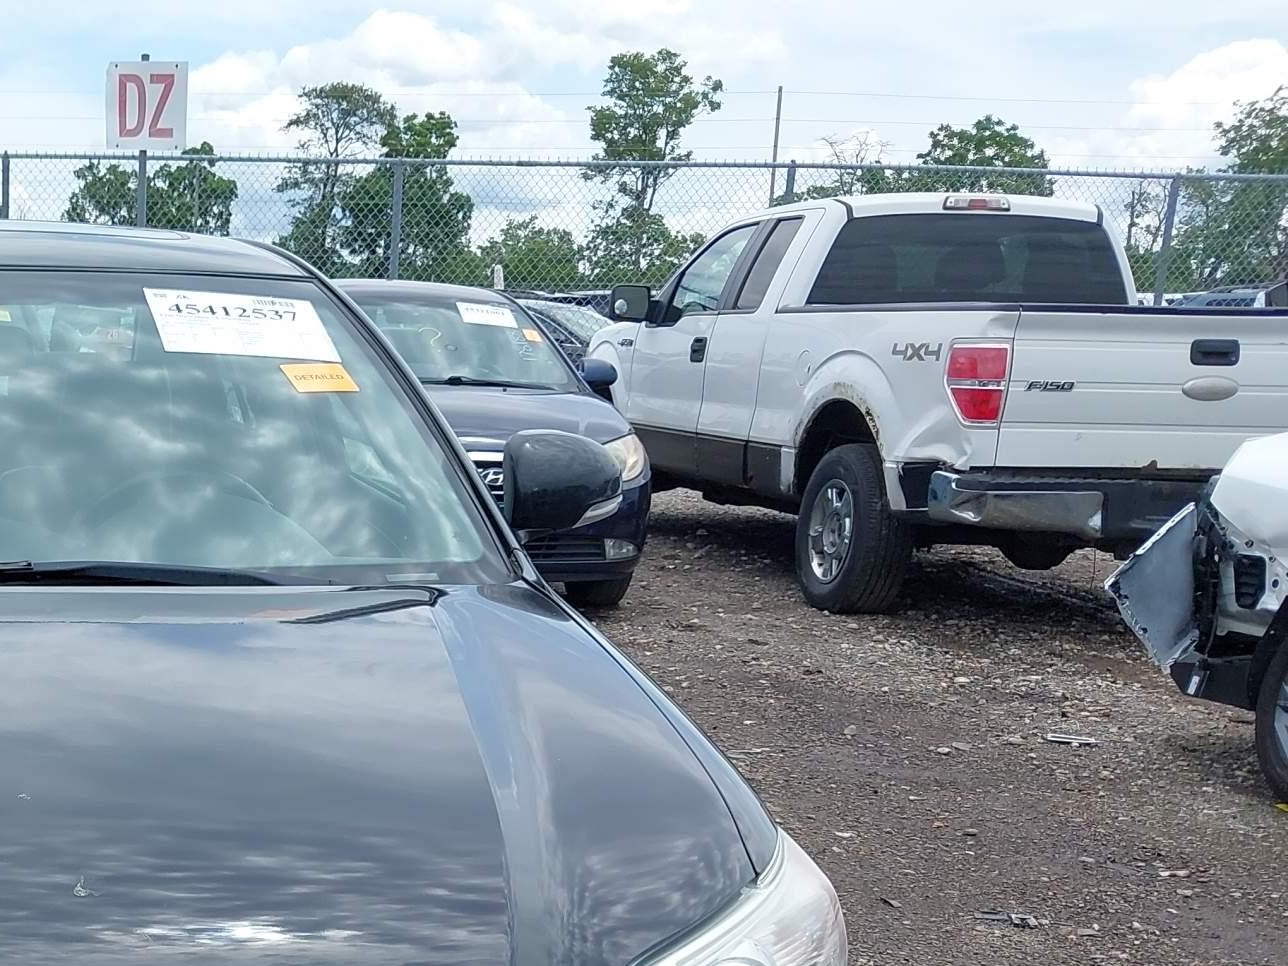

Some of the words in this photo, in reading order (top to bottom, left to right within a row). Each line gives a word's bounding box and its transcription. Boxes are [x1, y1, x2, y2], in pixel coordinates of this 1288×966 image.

[118, 73, 176, 138] DZ
[168, 303, 297, 322] 45412537
[892, 343, 943, 361] 4X4
